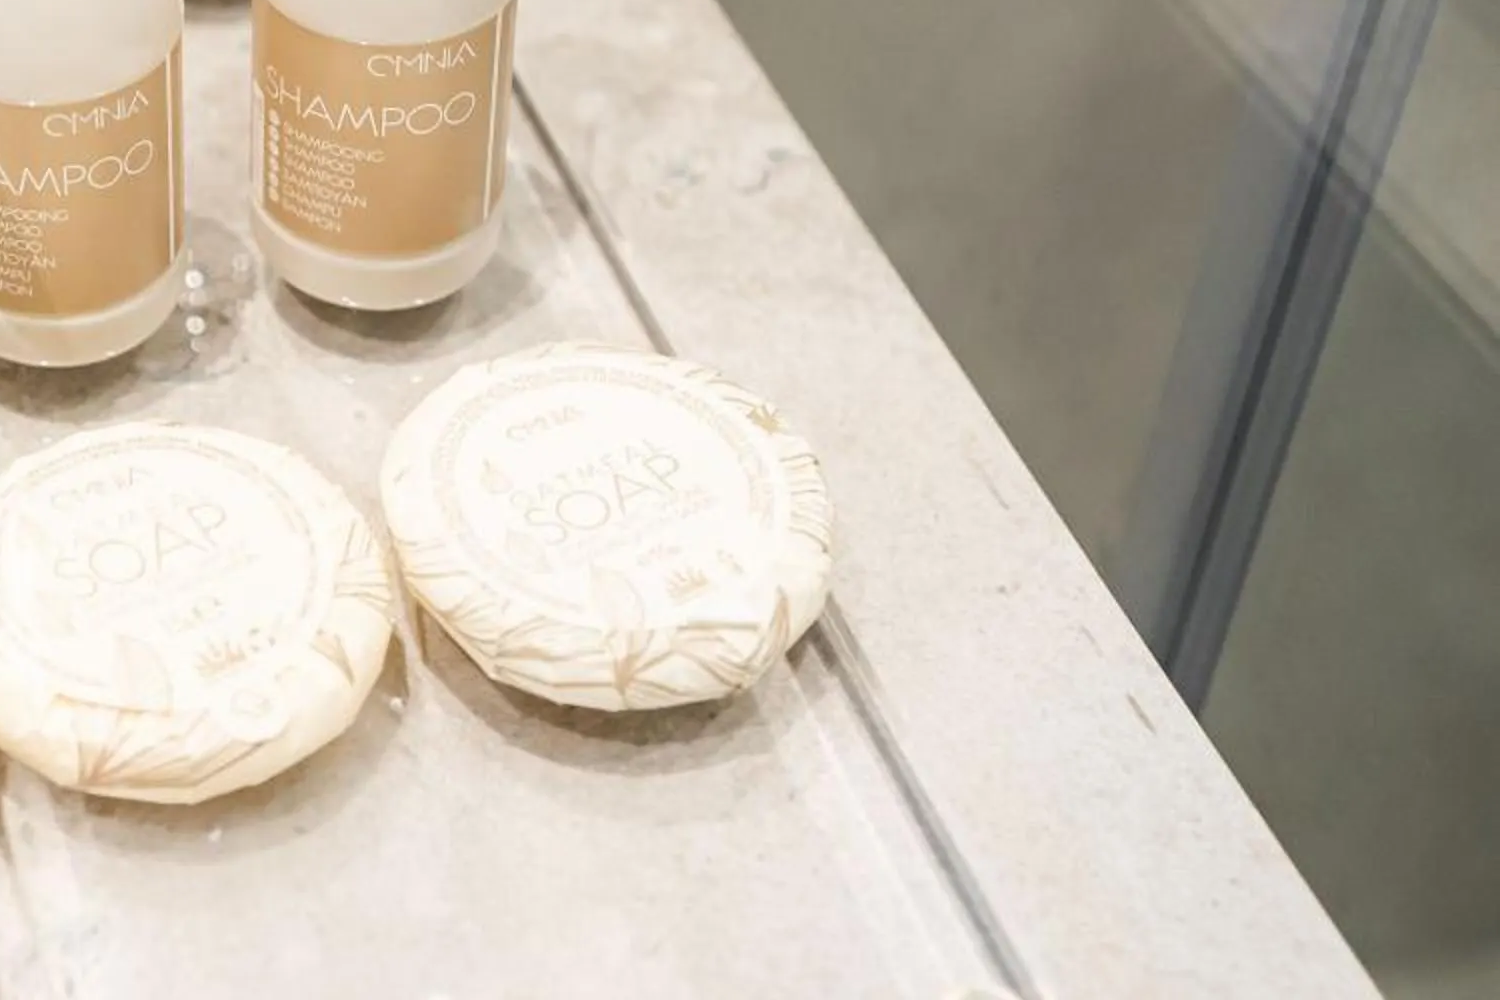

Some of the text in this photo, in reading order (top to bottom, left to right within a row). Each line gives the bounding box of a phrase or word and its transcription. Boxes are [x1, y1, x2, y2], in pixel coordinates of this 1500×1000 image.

[265, 65, 475, 137] SHAMPOO
[524, 453, 681, 546] SOAP
[53, 502, 227, 598] SOAP
